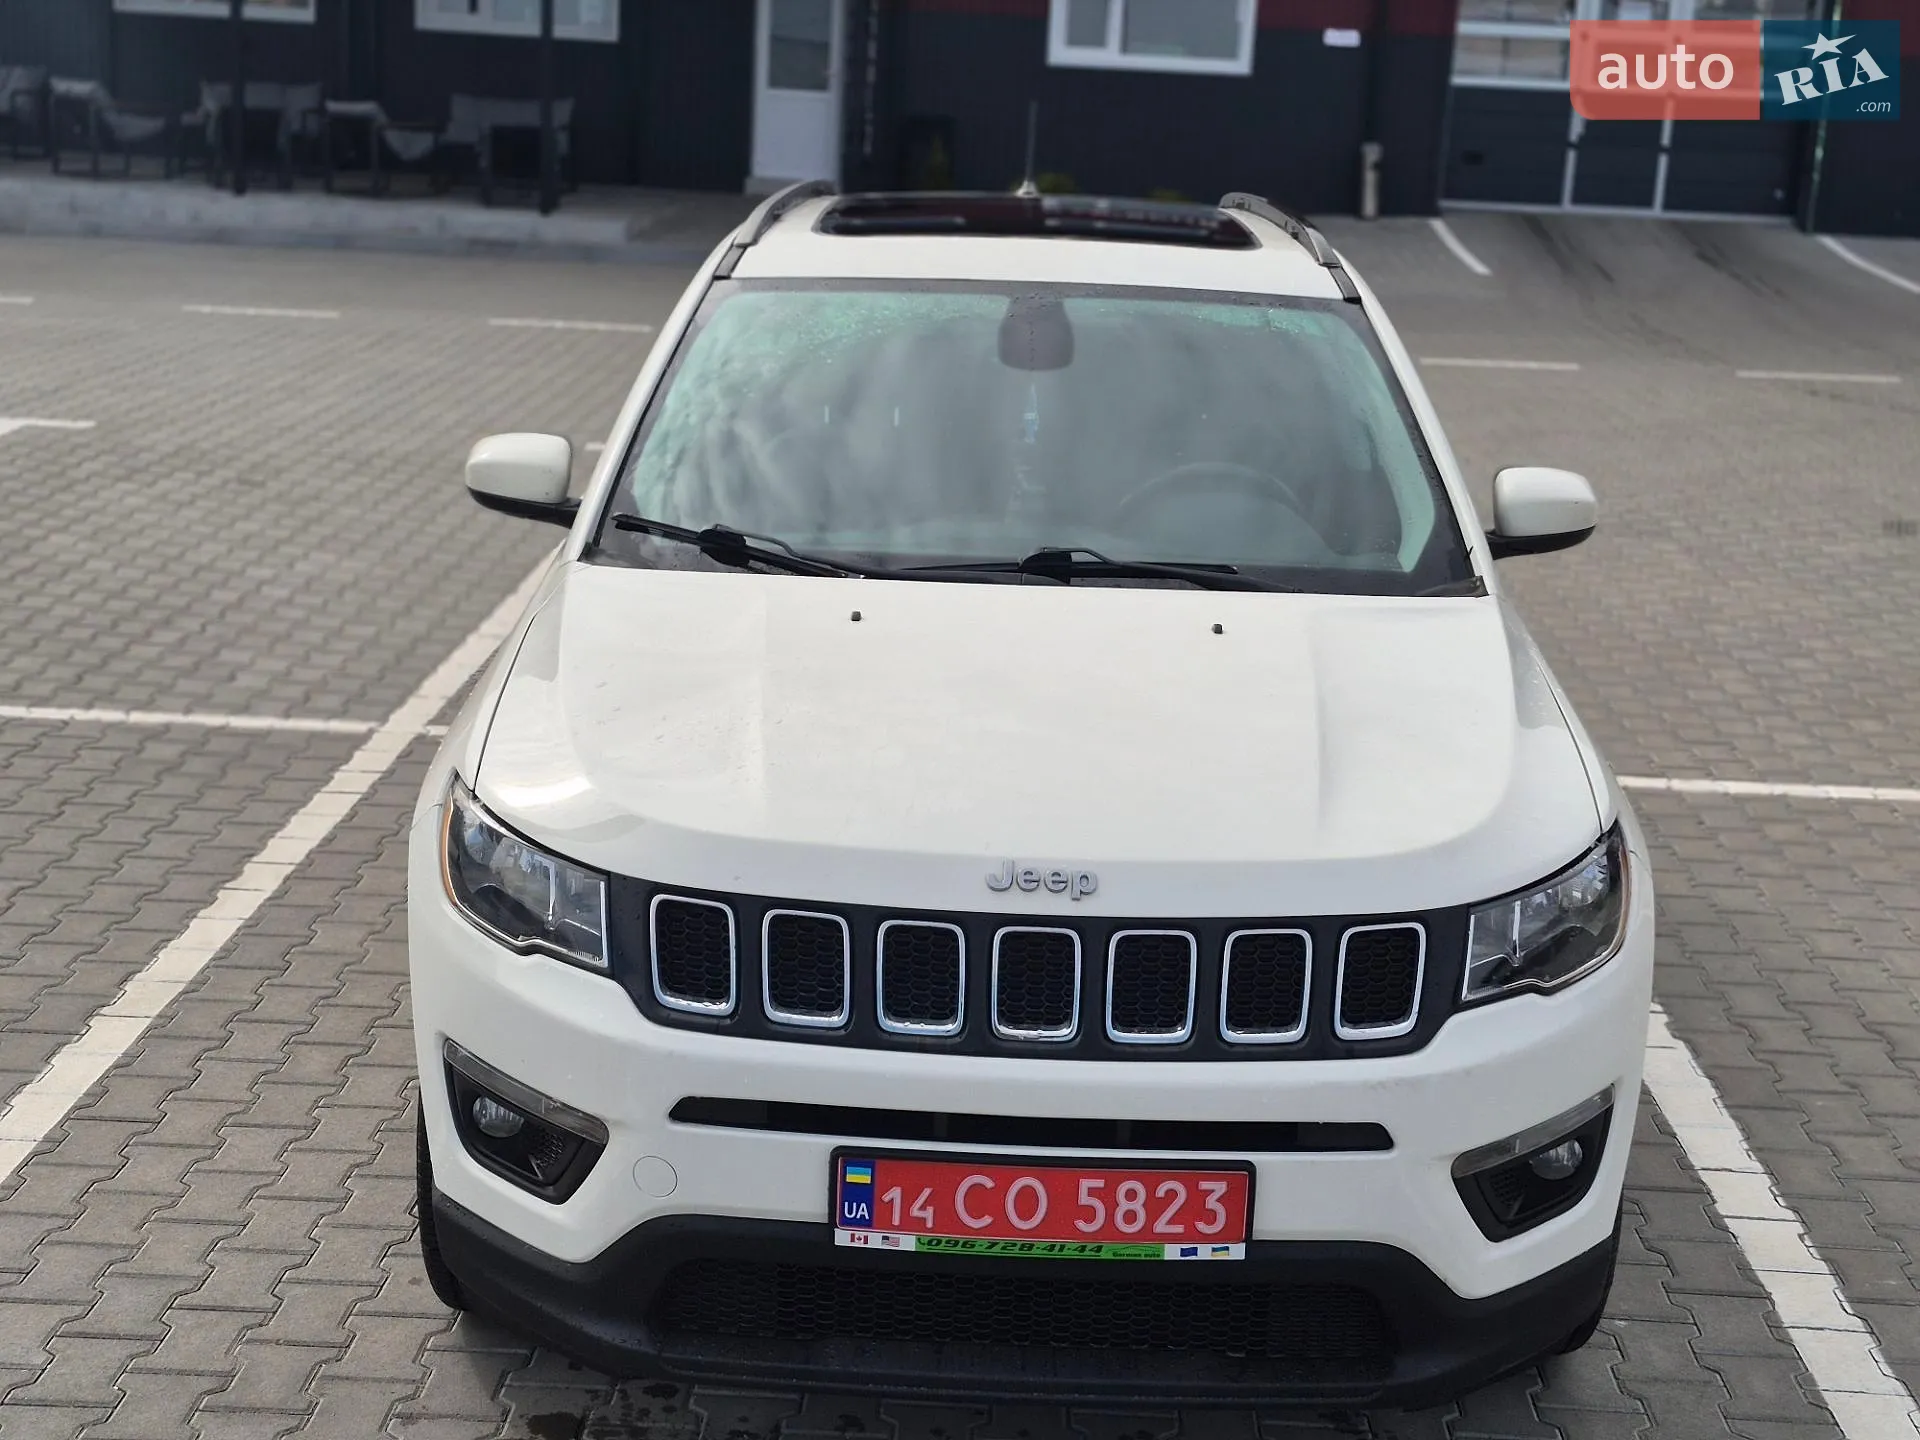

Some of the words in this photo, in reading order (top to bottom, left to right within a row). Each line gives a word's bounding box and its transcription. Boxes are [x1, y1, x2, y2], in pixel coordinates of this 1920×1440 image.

[985, 857, 1098, 901] Jeep
[844, 1201, 869, 1219] UA
[881, 1186, 935, 1229] 14
[954, 1174, 1048, 1231] CO
[1073, 1178, 1228, 1234] 5823
[926, 1237, 1104, 1254] 096-728-41-44
